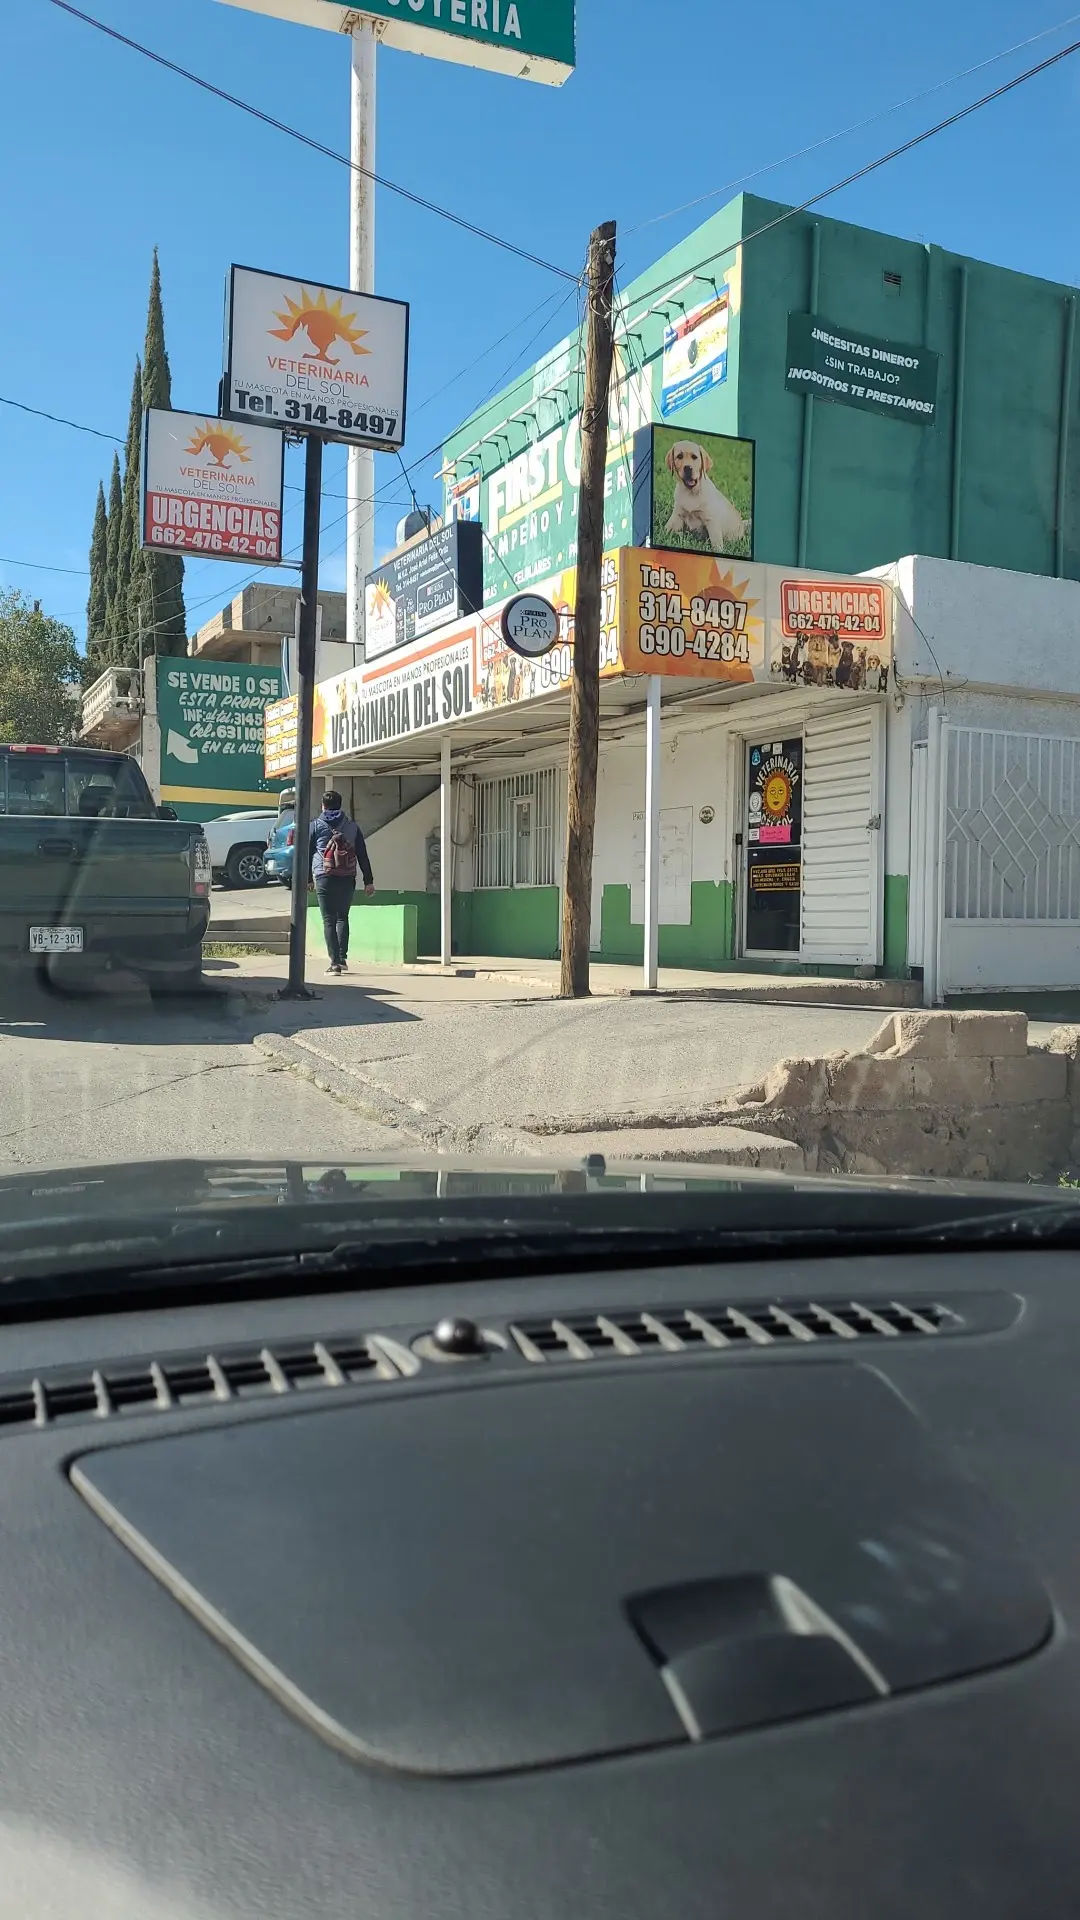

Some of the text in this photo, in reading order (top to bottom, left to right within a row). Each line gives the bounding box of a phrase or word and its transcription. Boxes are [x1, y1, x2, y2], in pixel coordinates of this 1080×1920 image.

[387, 0, 522, 39] YERIA
[811, 328, 919, 369] ¿NECESITAS DINERO?
[267, 356, 370, 387] VETERINARIA
[825, 355, 900, 385] ¿SIN TRABAJO?
[234, 379, 244, 387] TU
[245, 381, 289, 396] MASCOTA
[303, 393, 335, 405] MANOS
[337, 399, 399, 417] PROFESIONALES
[286, 374, 350, 398] DEL SOL
[788, 368, 934, 414] ¡NOSOTROS TE PRESTAMOS!
[235, 390, 397, 437] Tel. 314-8497
[179, 466, 256, 486] VETERINARIA
[193, 478, 242, 495] DEL SOL
[485, 426, 563, 537] FIRST
[164, 487, 196, 497] MASCOTA
[206, 493, 230, 501] MANOS
[231, 496, 277, 508] PROFESIONALES
[152, 496, 279, 539] URGENCIAS
[556, 501, 563, 525] Y
[151, 525, 278, 557] 662-476-42-04
[393, 542, 429, 571] VETERINARIA
[429, 536, 440, 550] DEL
[441, 528, 454, 543] SOL
[640, 565, 679, 590] Tels.
[419, 588, 453, 615] PRO PLAN
[639, 591, 747, 630] 314-8497
[787, 590, 880, 616] URGENCIAS
[513, 626, 552, 639] PLAN
[521, 616, 548, 629] PRO
[788, 613, 880, 632] 662-476-42-04
[639, 623, 749, 663] 690-4284
[167, 671, 188, 689] SE
[190, 673, 240, 693] VENDE
[259, 678, 279, 696] SE
[368, 681, 393, 697] MASCOTA
[401, 667, 422, 685] MANOS
[423, 646, 469, 674] PROFESIONALES
[179, 692, 217, 707] ESTA
[331, 687, 411, 754] VETERINARIA
[413, 676, 439, 729] DEL
[442, 663, 473, 720] SOL
[216, 725, 241, 740] 631
[202, 741, 221, 754] EN
[222, 742, 236, 754] EL
[755, 755, 799, 786] VETERINARIA
[33, 934, 80, 944] VB-12-301
